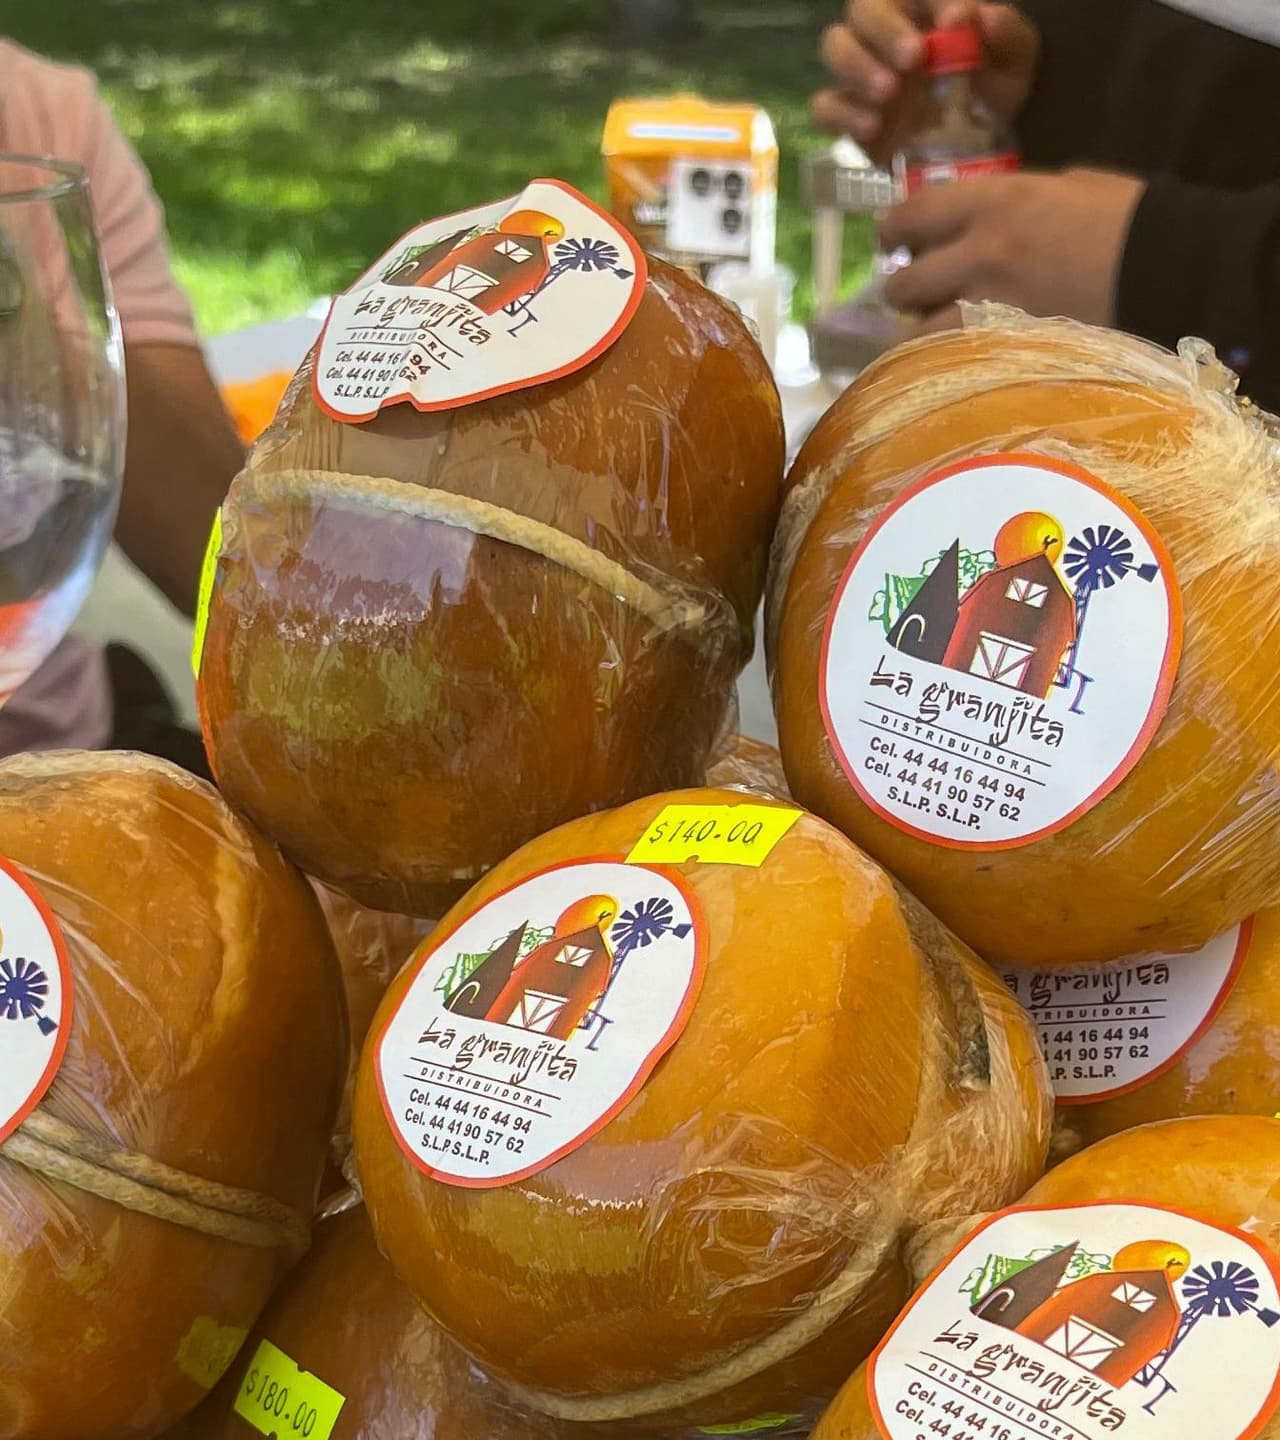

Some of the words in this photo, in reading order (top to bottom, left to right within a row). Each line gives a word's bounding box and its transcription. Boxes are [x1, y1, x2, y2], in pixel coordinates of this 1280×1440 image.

[870, 655, 913, 697] La
[915, 681, 1064, 748] granjita
[881, 714, 1031, 775] DISTRIBUIDORA
[864, 757, 891, 778] Cel.
[897, 768, 917, 786] 44
[922, 777, 942, 794] 41
[947, 785, 968, 803] 90
[973, 794, 995, 812] 57
[999, 803, 1021, 821] 62
[870, 736, 897, 758] Cel.
[903, 749, 923, 766] 44
[927, 757, 949, 775] 44
[954, 766, 973, 784] 16
[978, 775, 999, 793] 44
[1004, 784, 1026, 801] 94
[887, 787, 930, 813] S.L.P.
[936, 804, 981, 830] S.L.P.
[418, 1016, 456, 1049] La
[450, 1033, 577, 1085] granjita
[1054, 1049, 1071, 1062] 41
[1079, 1048, 1097, 1061] 90
[1104, 1046, 1123, 1060] 57
[1129, 1045, 1149, 1058] 62
[1079, 1030, 1097, 1042] 16
[1104, 1028, 1122, 1041] 44
[1129, 1027, 1149, 1039] 94
[421, 1067, 542, 1107] DISTRIBUIDORA
[405, 1108, 425, 1126] Cel.
[429, 1115, 445, 1131] 44
[448, 1121, 462, 1135] 41
[464, 1124, 481, 1139] 90
[485, 1130, 503, 1146] 57
[506, 1137, 524, 1153] 62
[410, 1088, 431, 1106] Cel.
[435, 1095, 451, 1110] 44
[453, 1099, 469, 1115] 44
[472, 1105, 490, 1120] 16
[491, 1111, 511, 1127] 44
[513, 1117, 532, 1133] 94
[421, 1134, 451, 1152] S.L.P.
[452, 1142, 490, 1165] S.L.P.
[933, 1319, 980, 1351] La
[965, 1344, 1127, 1431] granjita
[246, 1367, 317, 1438] $180.00
[895, 1400, 923, 1424] Cel.
[929, 1419, 951, 1437] 44
[908, 1382, 936, 1406] Cel.
[941, 1400, 964, 1418] 44
[965, 1412, 988, 1430] 44
